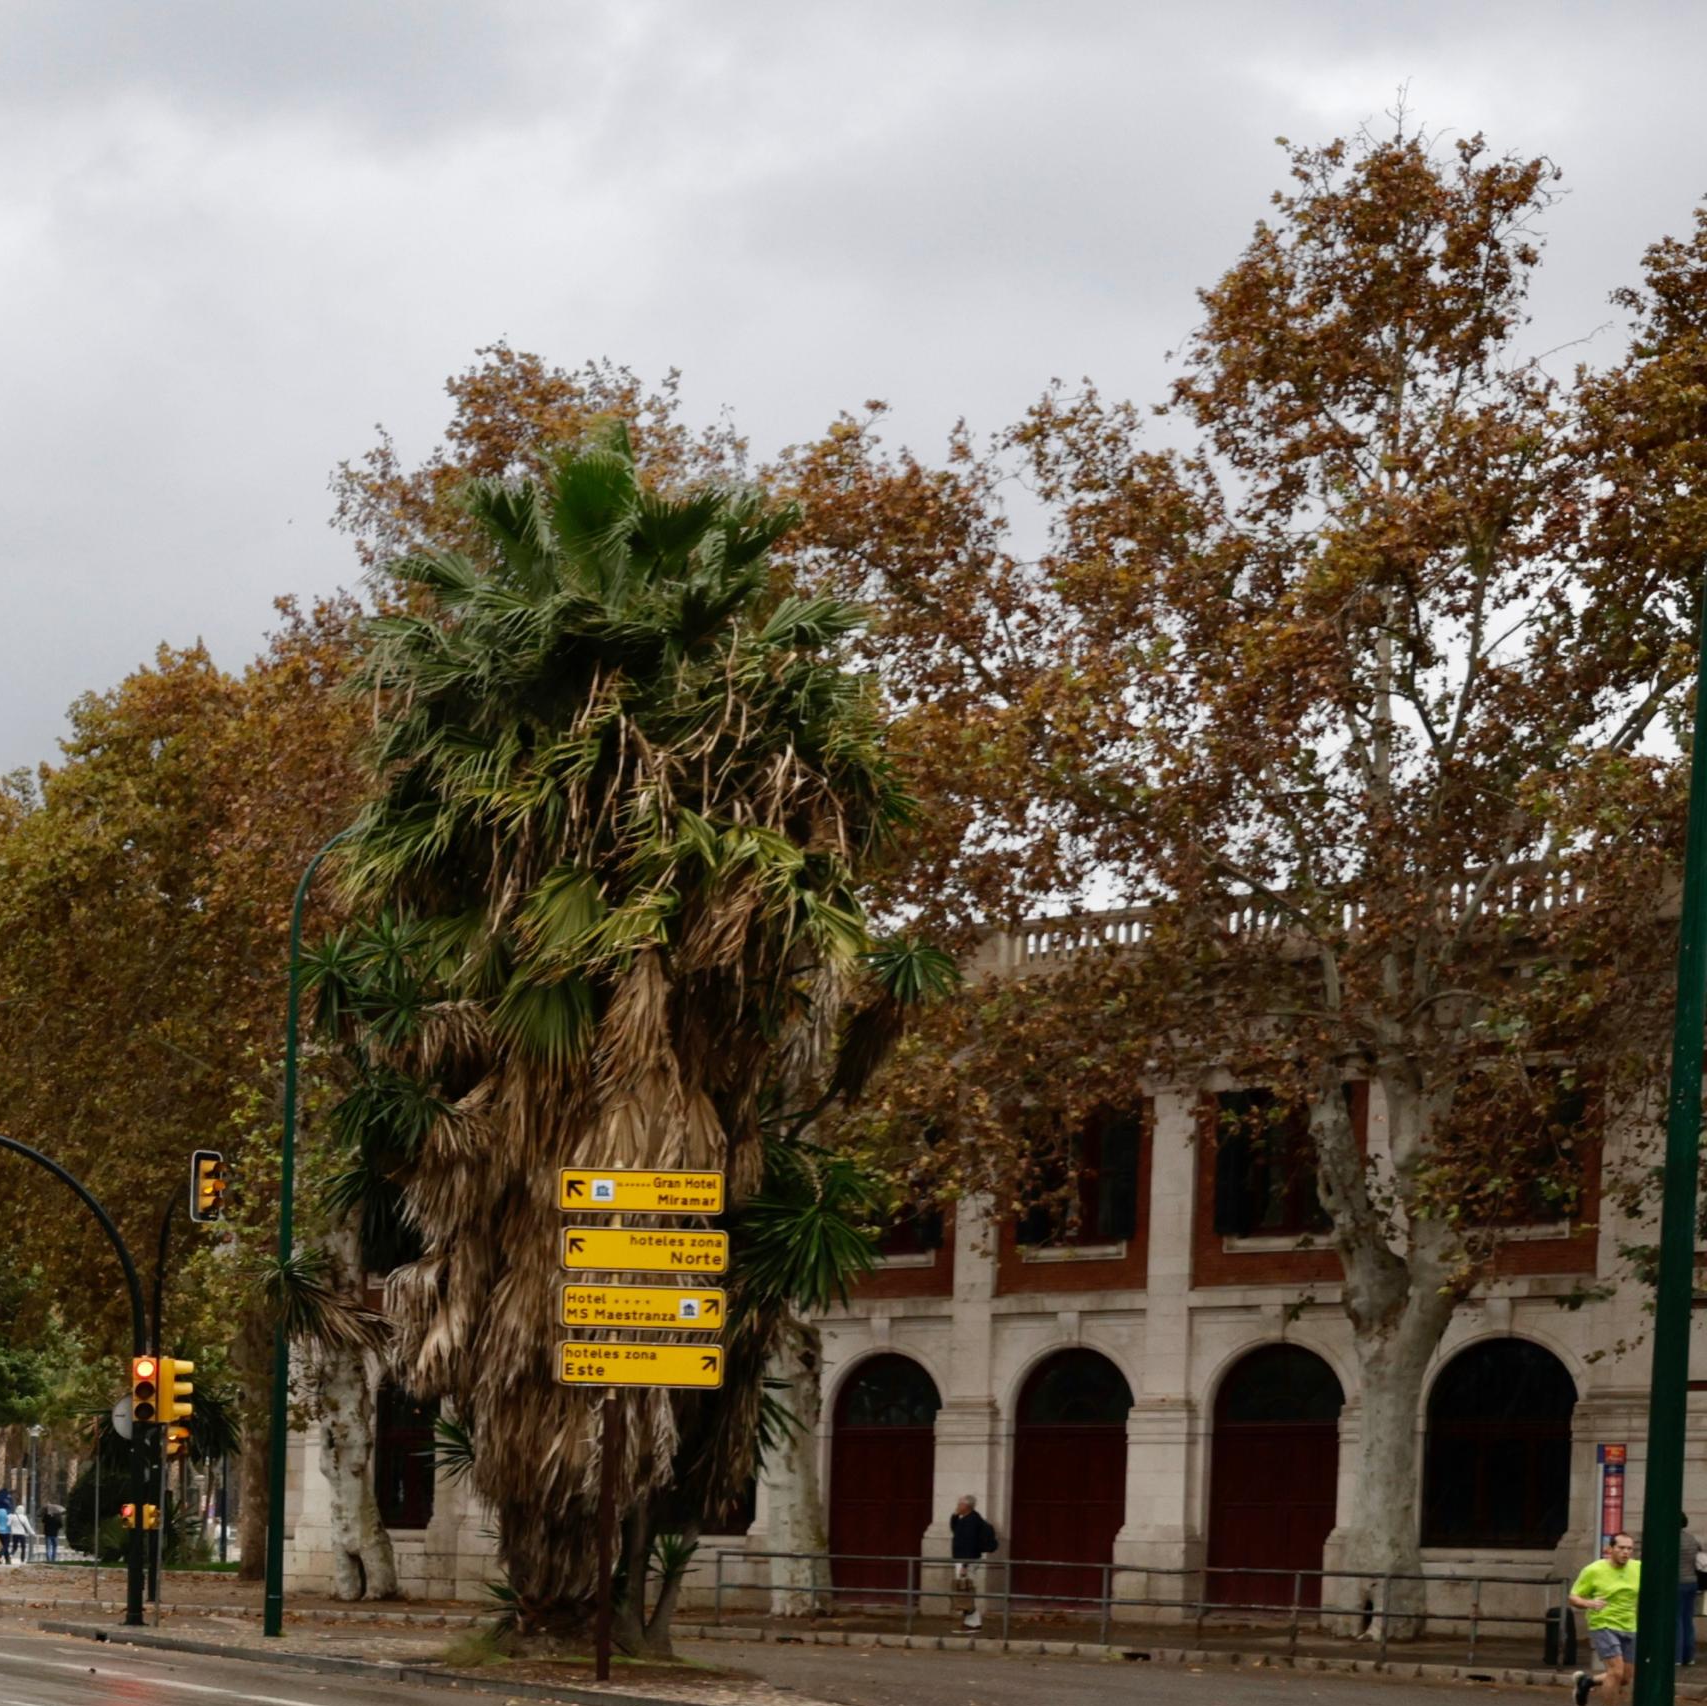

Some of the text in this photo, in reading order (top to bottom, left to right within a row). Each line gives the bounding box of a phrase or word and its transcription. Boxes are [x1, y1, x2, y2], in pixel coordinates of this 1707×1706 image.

[653, 1177, 717, 1190] Gran Hotel
[657, 1195, 717, 1206] Miramar
[630, 1235, 723, 1248] hoteles zona
[671, 1252, 723, 1265] Norte
[566, 1293, 607, 1304] Hotel
[566, 1308, 677, 1322] MS Maestranza
[565, 1348, 657, 1360] hoteles zona
[564, 1363, 606, 1376] Este
